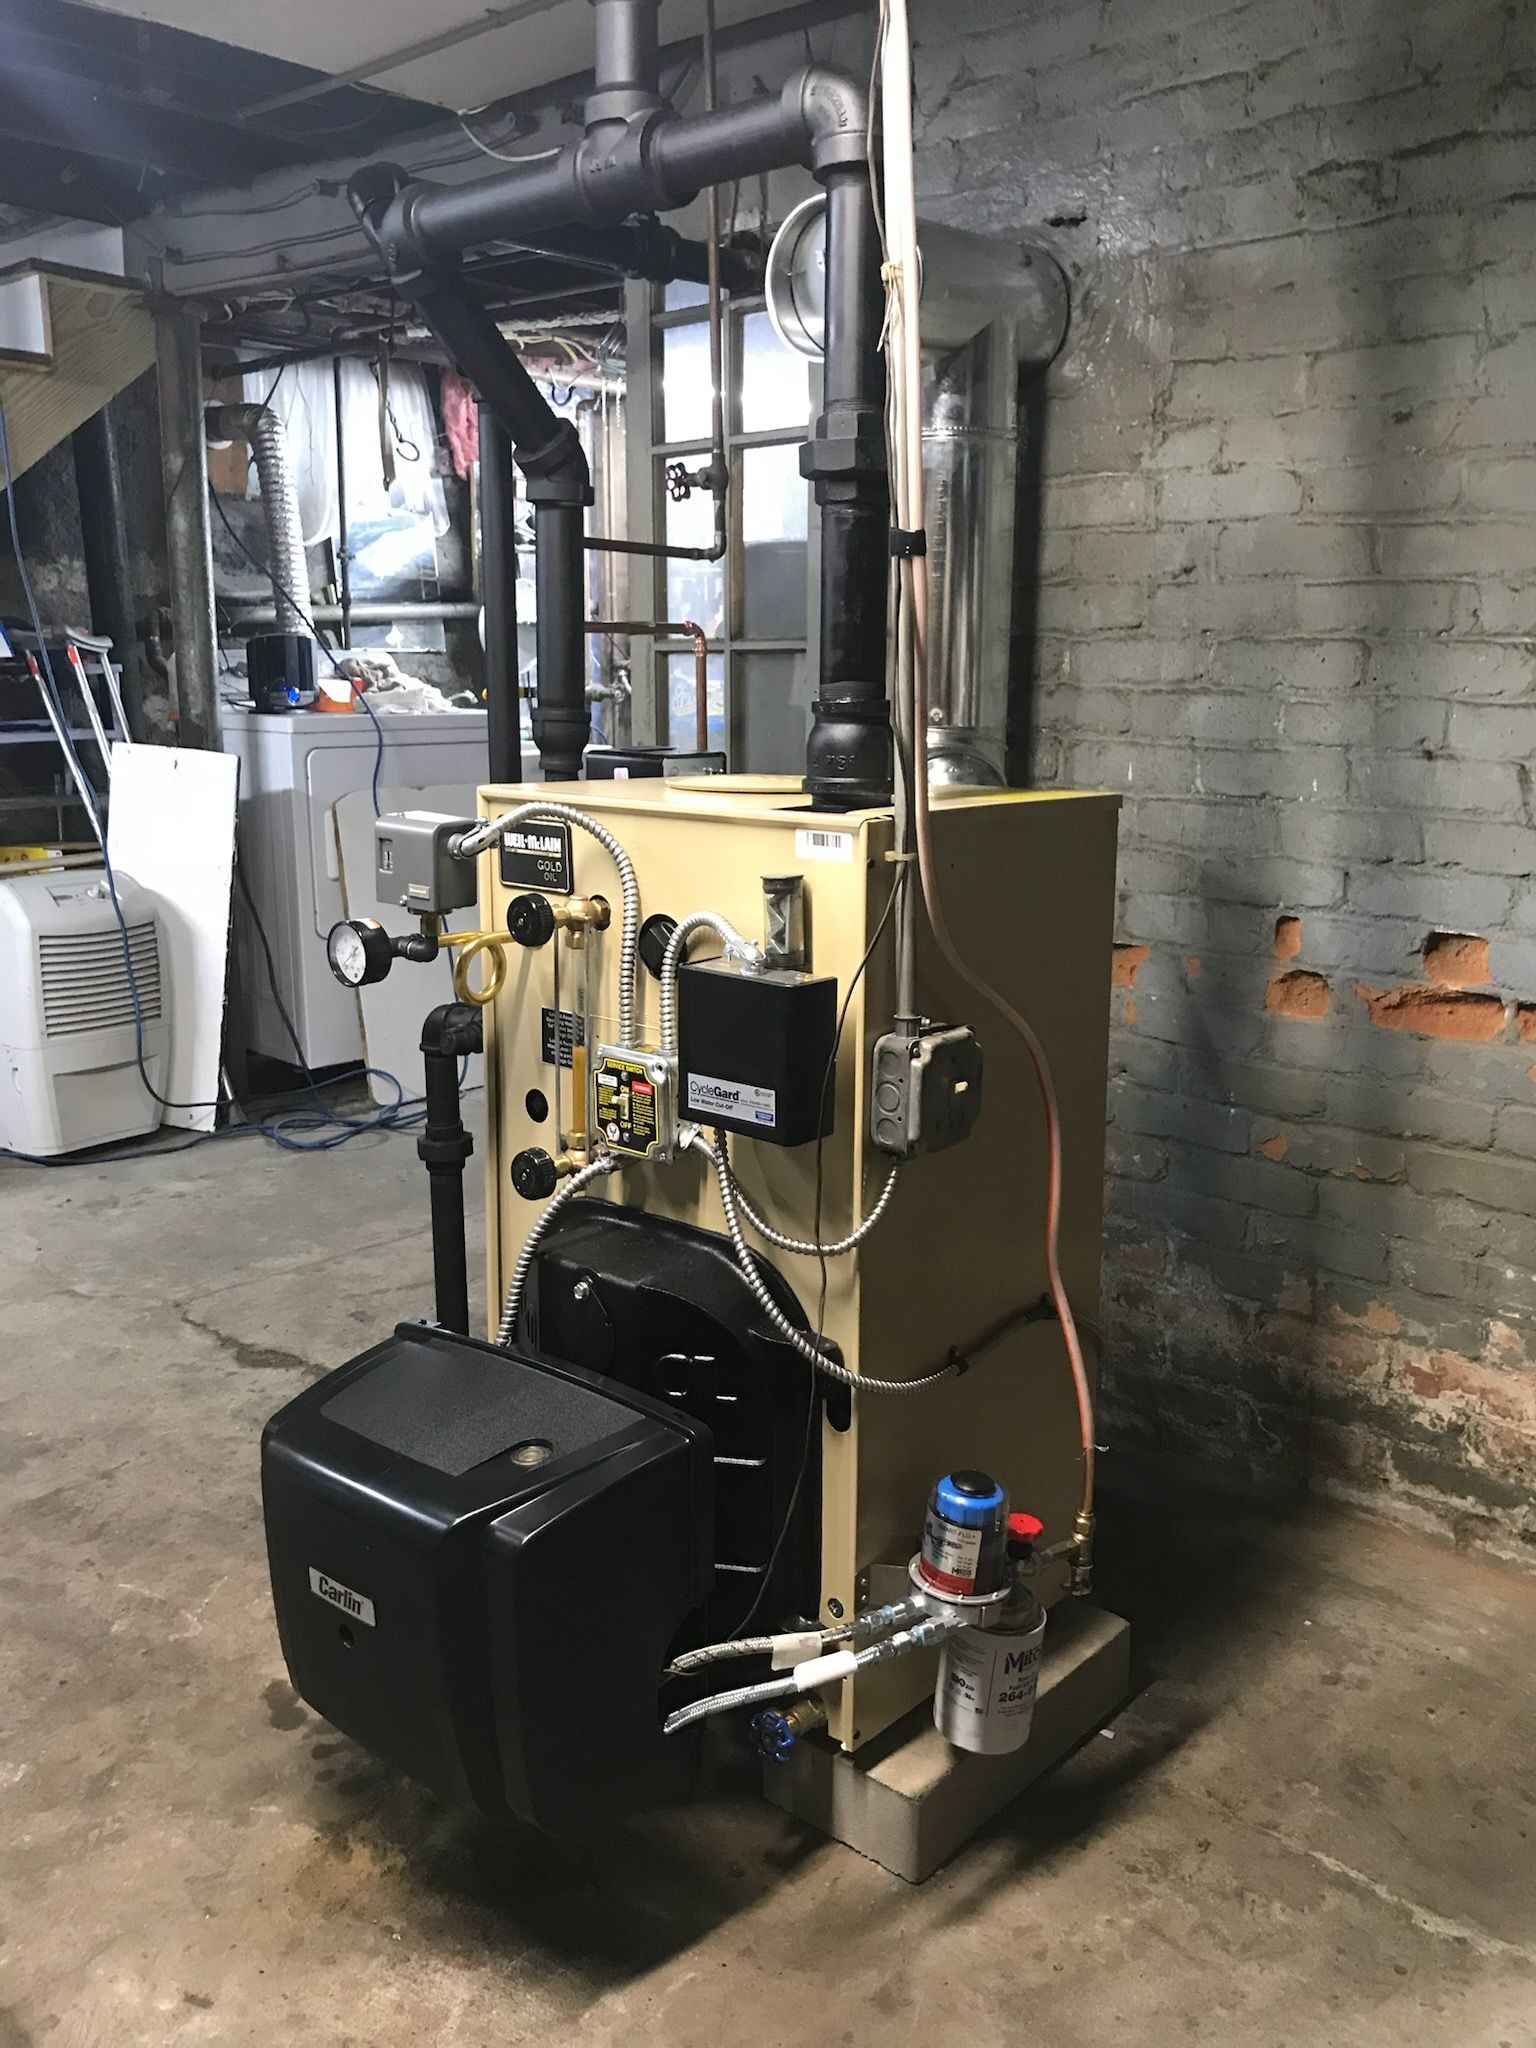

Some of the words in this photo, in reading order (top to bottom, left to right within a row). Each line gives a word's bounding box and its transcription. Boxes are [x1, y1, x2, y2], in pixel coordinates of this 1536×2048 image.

[537, 860, 562, 872] GOLD
[544, 872, 557, 882] OIL
[606, 1061, 625, 1071] SERVICE
[620, 1085, 630, 1093] ON
[690, 1081, 739, 1100] CycleGard
[701, 1098, 714, 1106] Water
[715, 1101, 733, 1110] Cut-Off
[620, 1120, 632, 1129] OFF
[319, 1576, 361, 1615] Carlin
